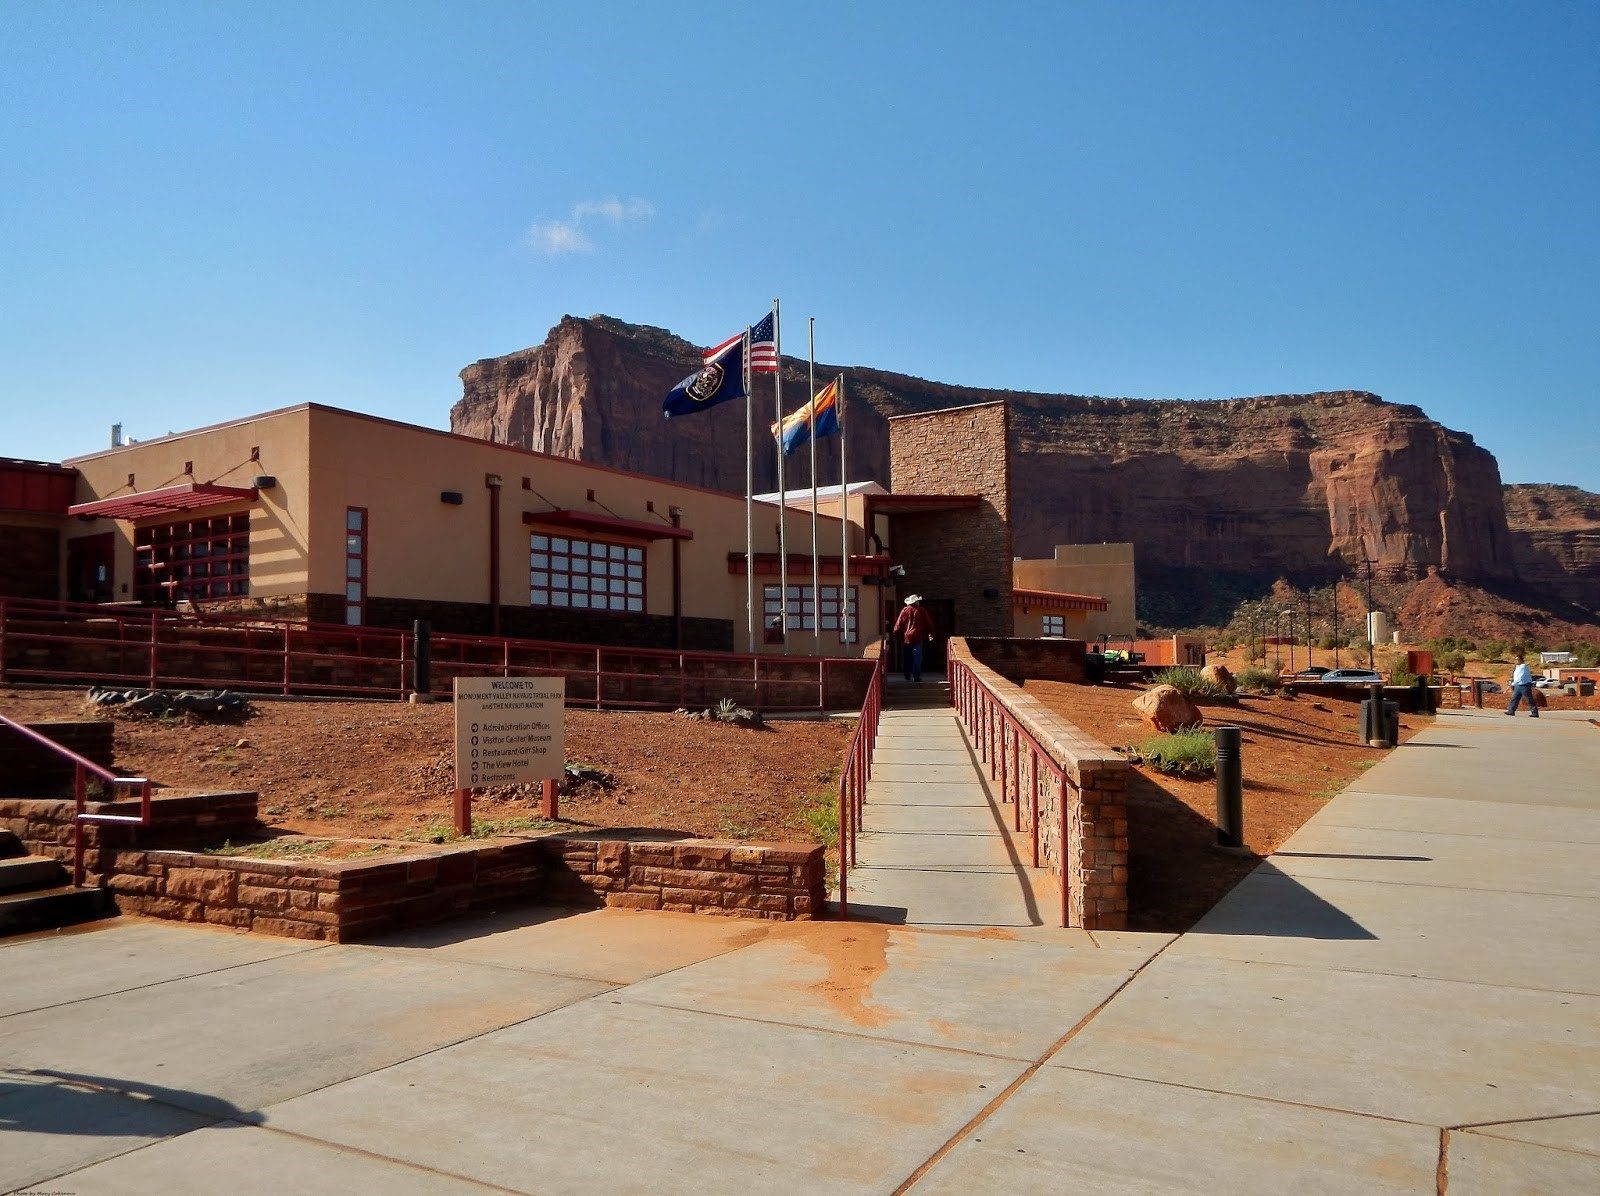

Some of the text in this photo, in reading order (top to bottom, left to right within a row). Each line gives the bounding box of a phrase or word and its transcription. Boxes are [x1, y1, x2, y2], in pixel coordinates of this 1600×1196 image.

[491, 681, 534, 690] WELCOME TO
[458, 692, 492, 700] MONUMENT
[493, 692, 512, 700] VALLEY
[482, 722, 550, 732] Administration Offices
[482, 734, 552, 744] Visitor Center Museum
[532, 746, 547, 755] Shop
[482, 758, 529, 770] The View Hotel
[482, 772, 516, 782] Restrooms
